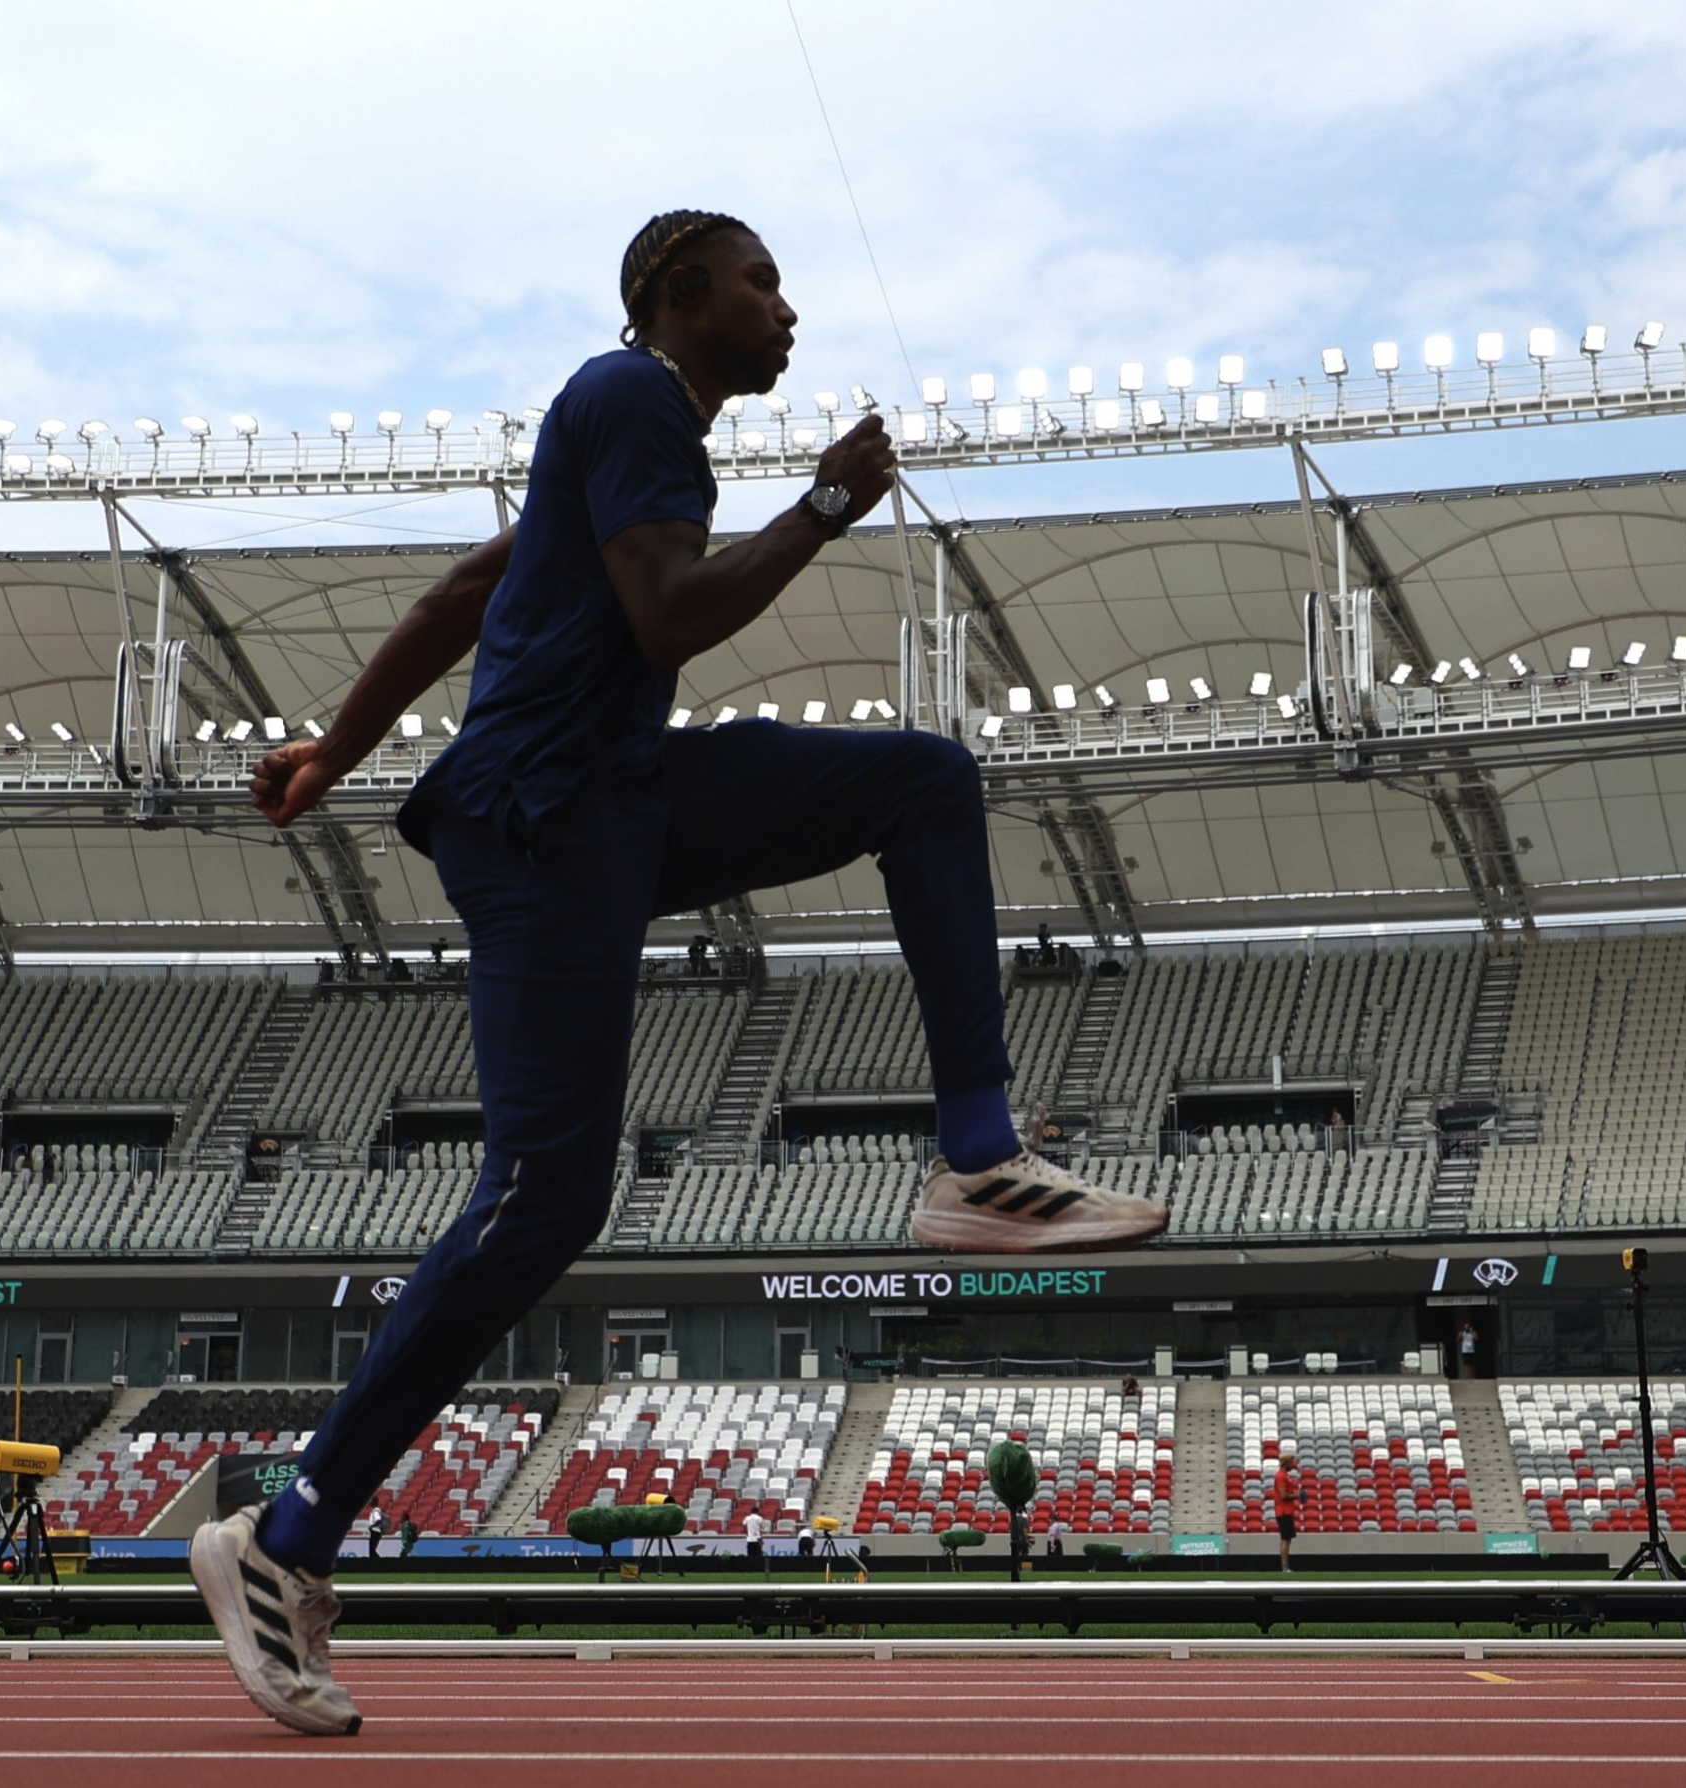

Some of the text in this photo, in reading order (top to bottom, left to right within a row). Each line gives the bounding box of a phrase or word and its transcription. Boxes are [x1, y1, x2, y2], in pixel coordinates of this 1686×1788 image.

[762, 1270, 1107, 1299] WELCOME TO BUDAPEST
[13, 1459, 46, 1470] SEIKO
[255, 1463, 299, 1480] LÁSS
